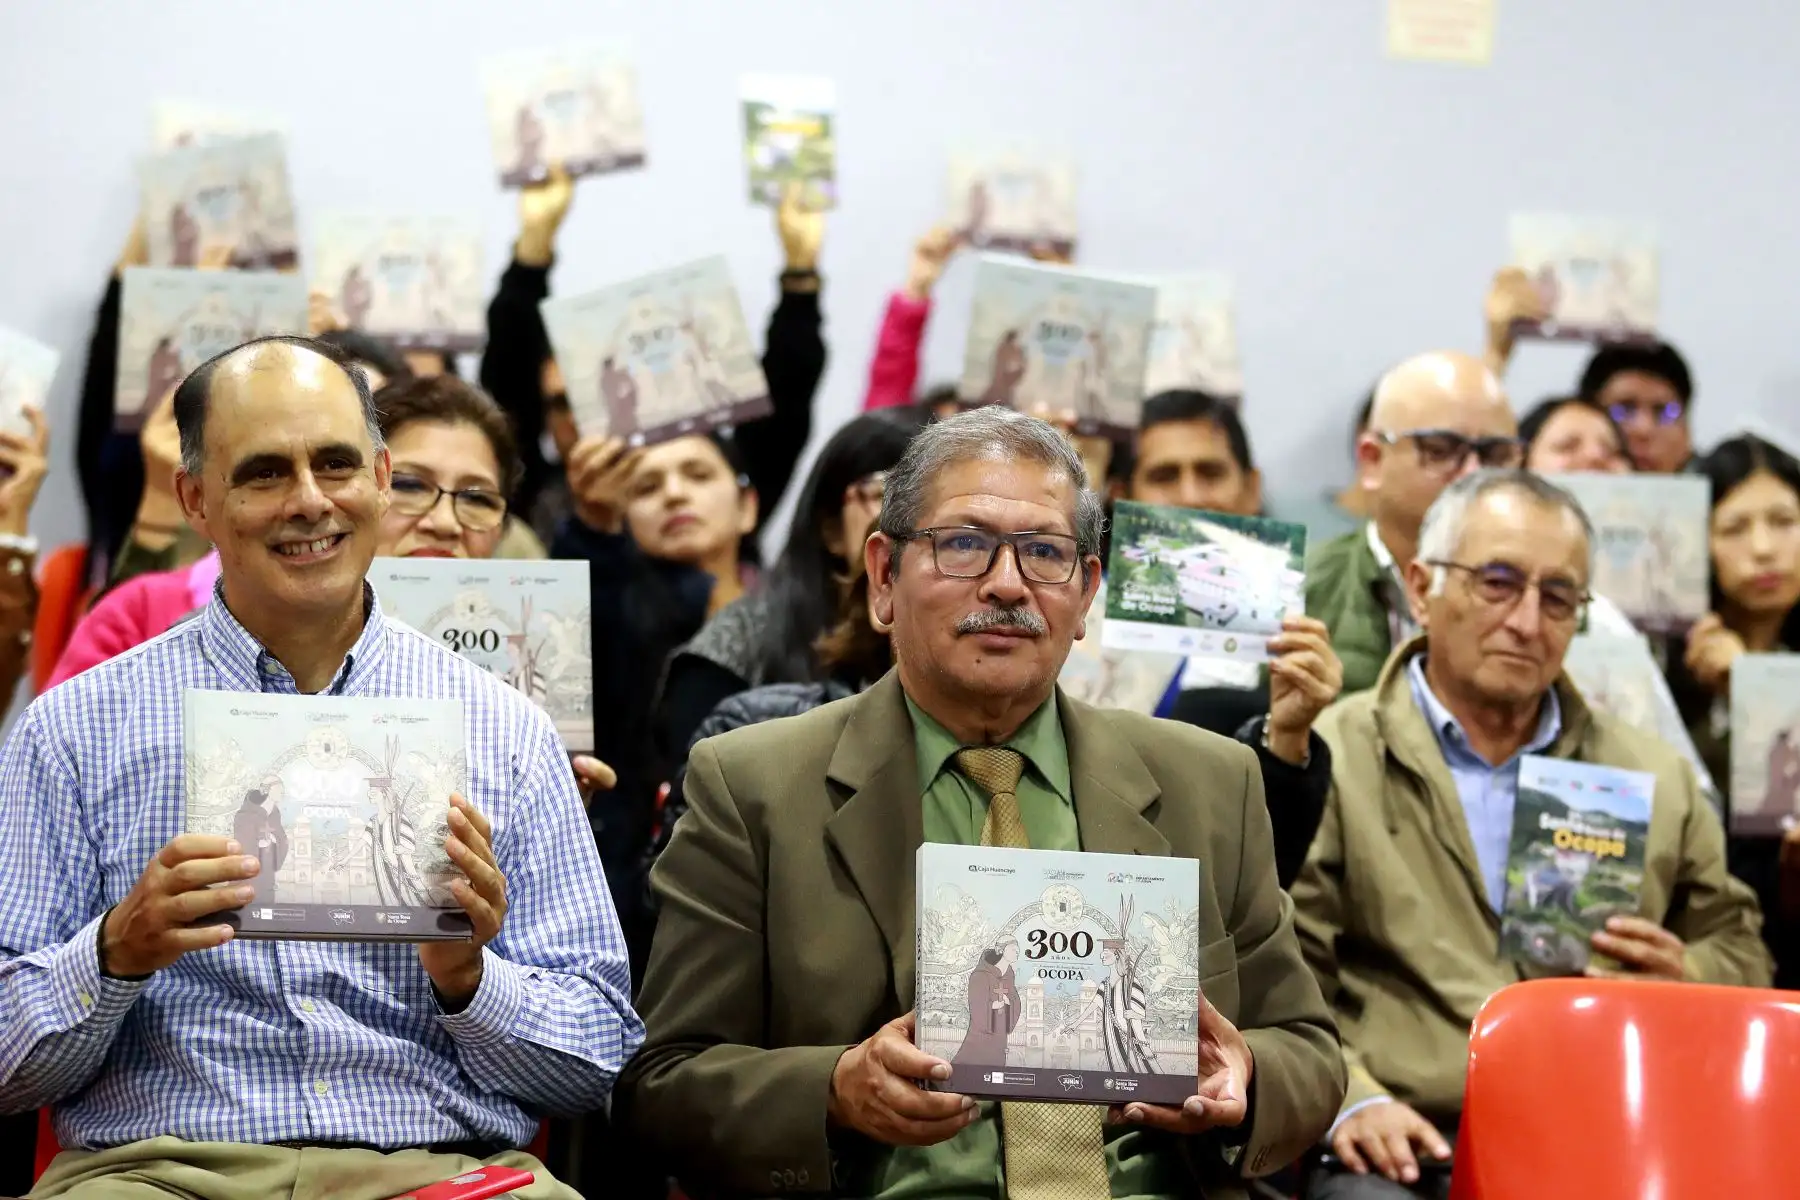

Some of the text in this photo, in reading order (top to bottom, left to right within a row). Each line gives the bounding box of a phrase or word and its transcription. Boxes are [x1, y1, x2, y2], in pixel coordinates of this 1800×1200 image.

[443, 628, 500, 653] 300
[303, 806, 353, 819] OCOPA
[1553, 828, 1626, 859] Ocopa
[1024, 929, 1094, 959] 300
[1038, 968, 1085, 981] OCOPA
